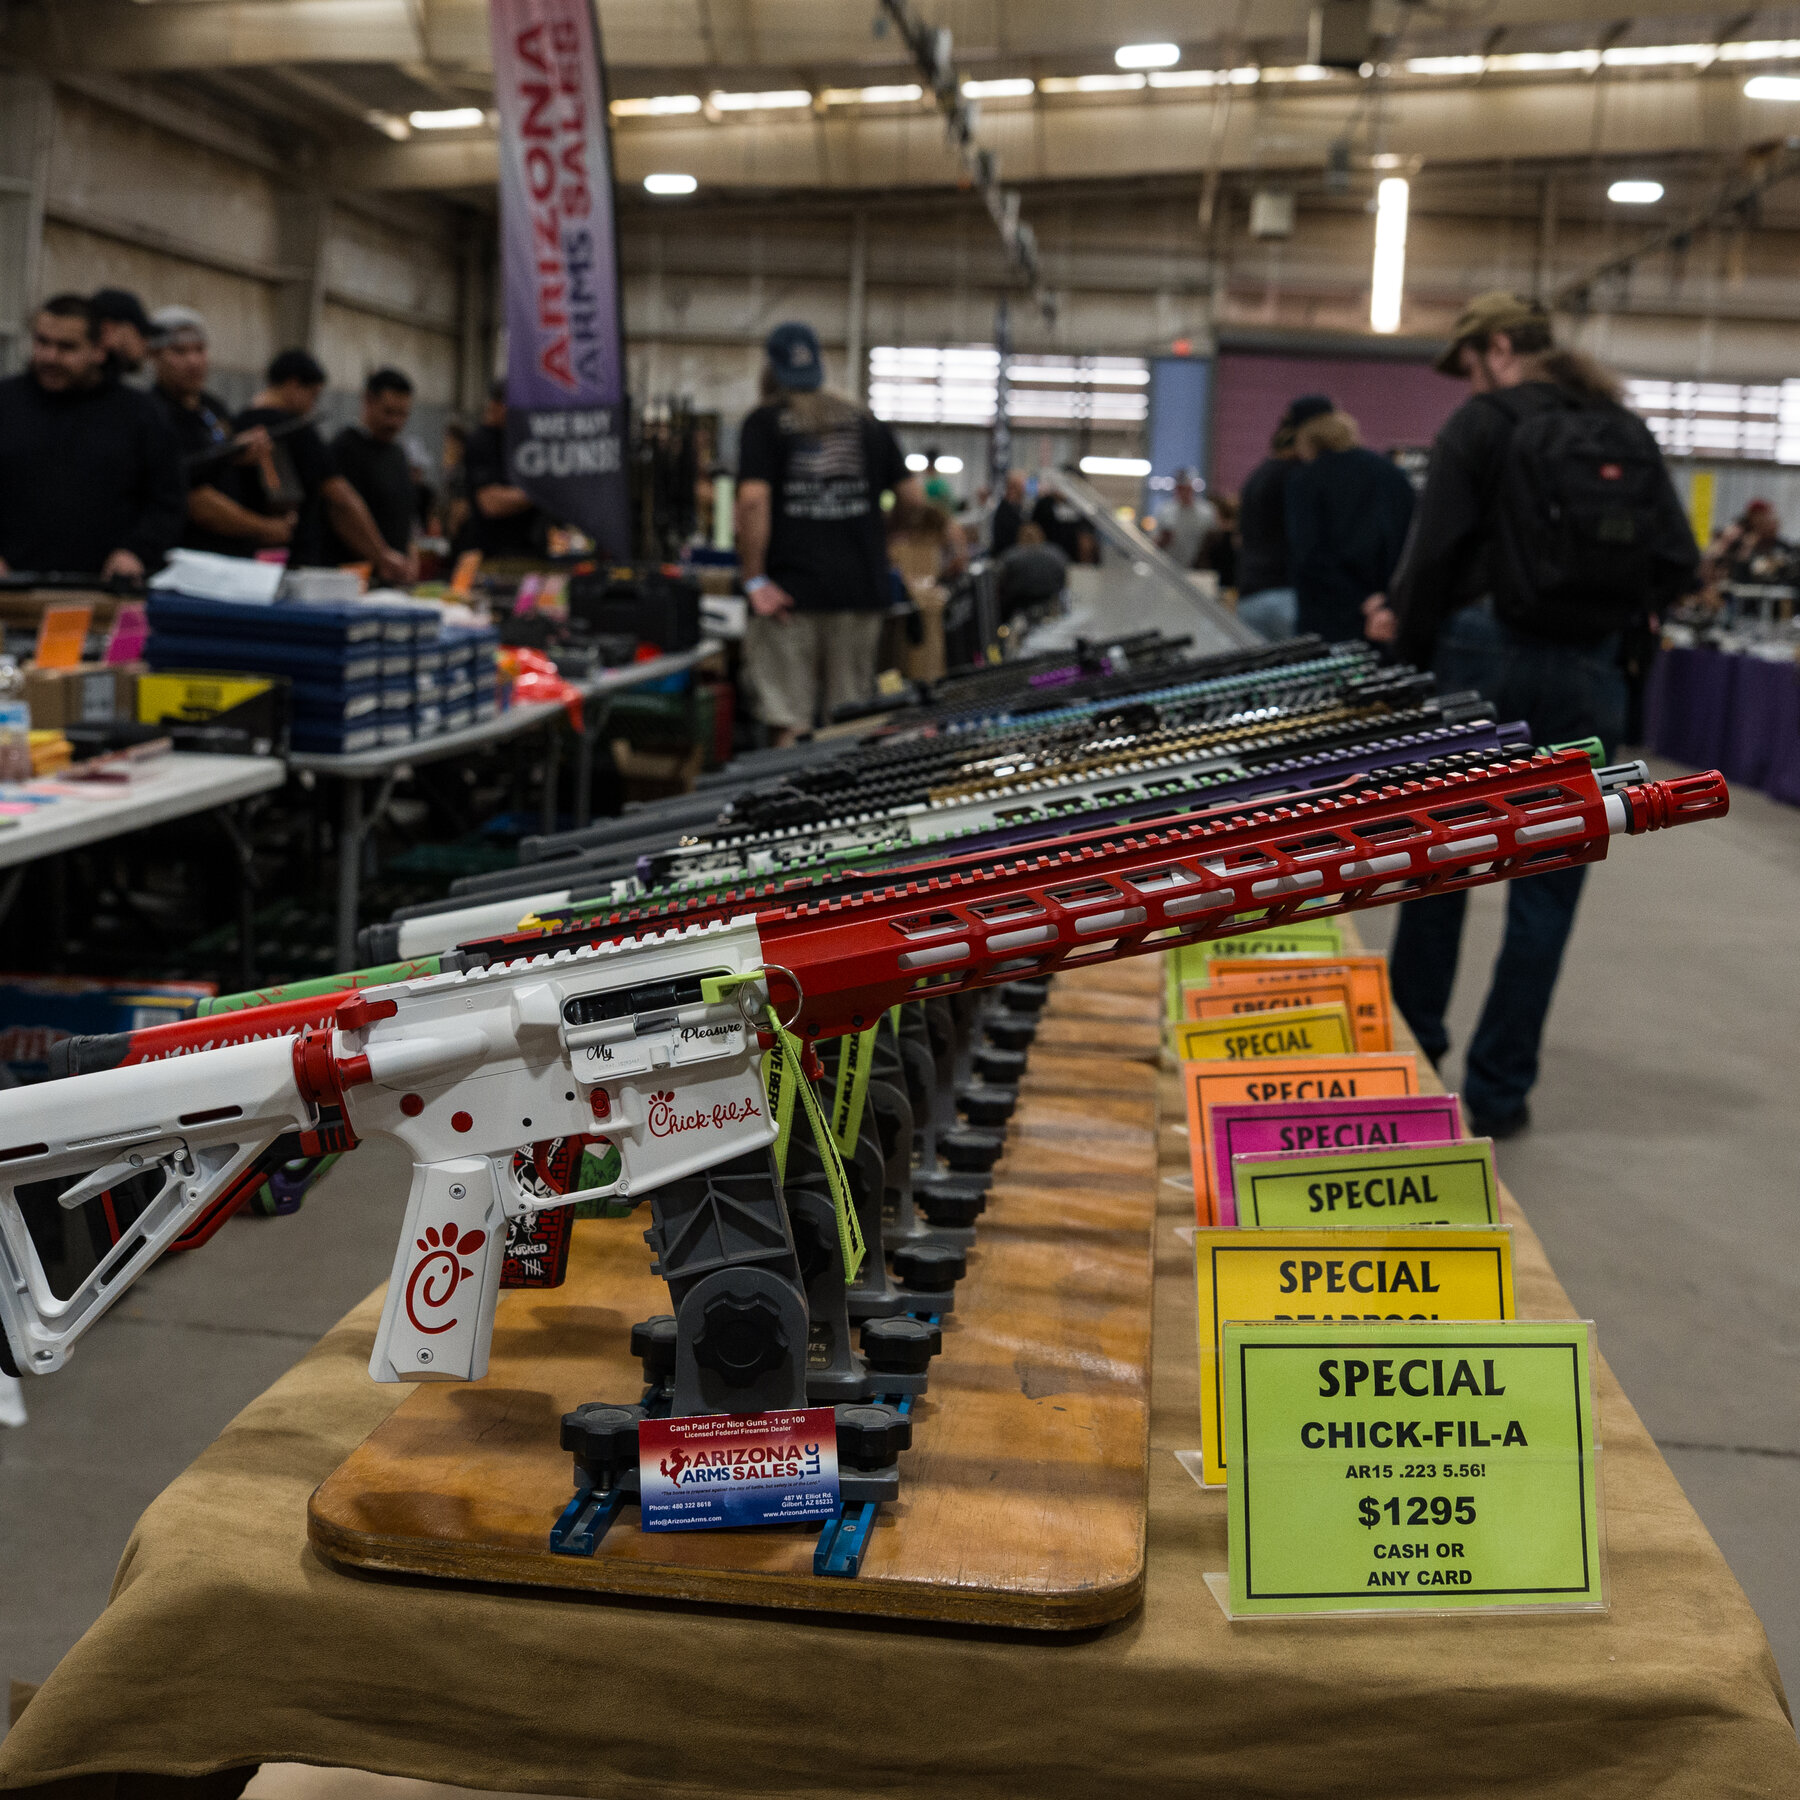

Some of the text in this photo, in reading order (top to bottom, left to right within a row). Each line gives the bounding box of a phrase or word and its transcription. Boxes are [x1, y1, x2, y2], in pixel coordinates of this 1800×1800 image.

[515, 23, 577, 391] ARIZONA
[552, 21, 603, 385] ARMS SALES
[586, 1022, 742, 1061] My Pleasure
[1224, 1028, 1312, 1059] SPECIAL
[1246, 1079, 1357, 1101] SPECIAL
[648, 1097, 762, 1137] Chick-fil-A
[1279, 1122, 1407, 1151] SPECIAL
[1307, 1175, 1438, 1213] SPECIAL
[1279, 1260, 1441, 1294] SPECIAL
[1318, 1358, 1507, 1398] SPECIAL
[669, 1424, 690, 1432] Cash
[692, 1422, 710, 1431] Paid
[711, 1421, 726, 1429] For
[727, 1420, 744, 1428] Nice
[746, 1419, 768, 1427] Guns
[774, 1417, 779, 1425] 1
[1300, 1420, 1529, 1449] CHICK-FIL-A
[692, 1444, 804, 1468] ARIZONA
[804, 1443, 821, 1475] LLC
[681, 1467, 731, 1484] ARMS
[1345, 1463, 1487, 1480] AR15 .223 5.56!
[649, 1515, 722, 1526] info@ArizonaArms.com
[672, 1502, 684, 1510] 480
[763, 1507, 834, 1518] www.ArizonaArms.com
[1358, 1495, 1477, 1530] $1295
[1373, 1543, 1465, 1560] CASH OR
[1366, 1570, 1473, 1587] ANY CARD
